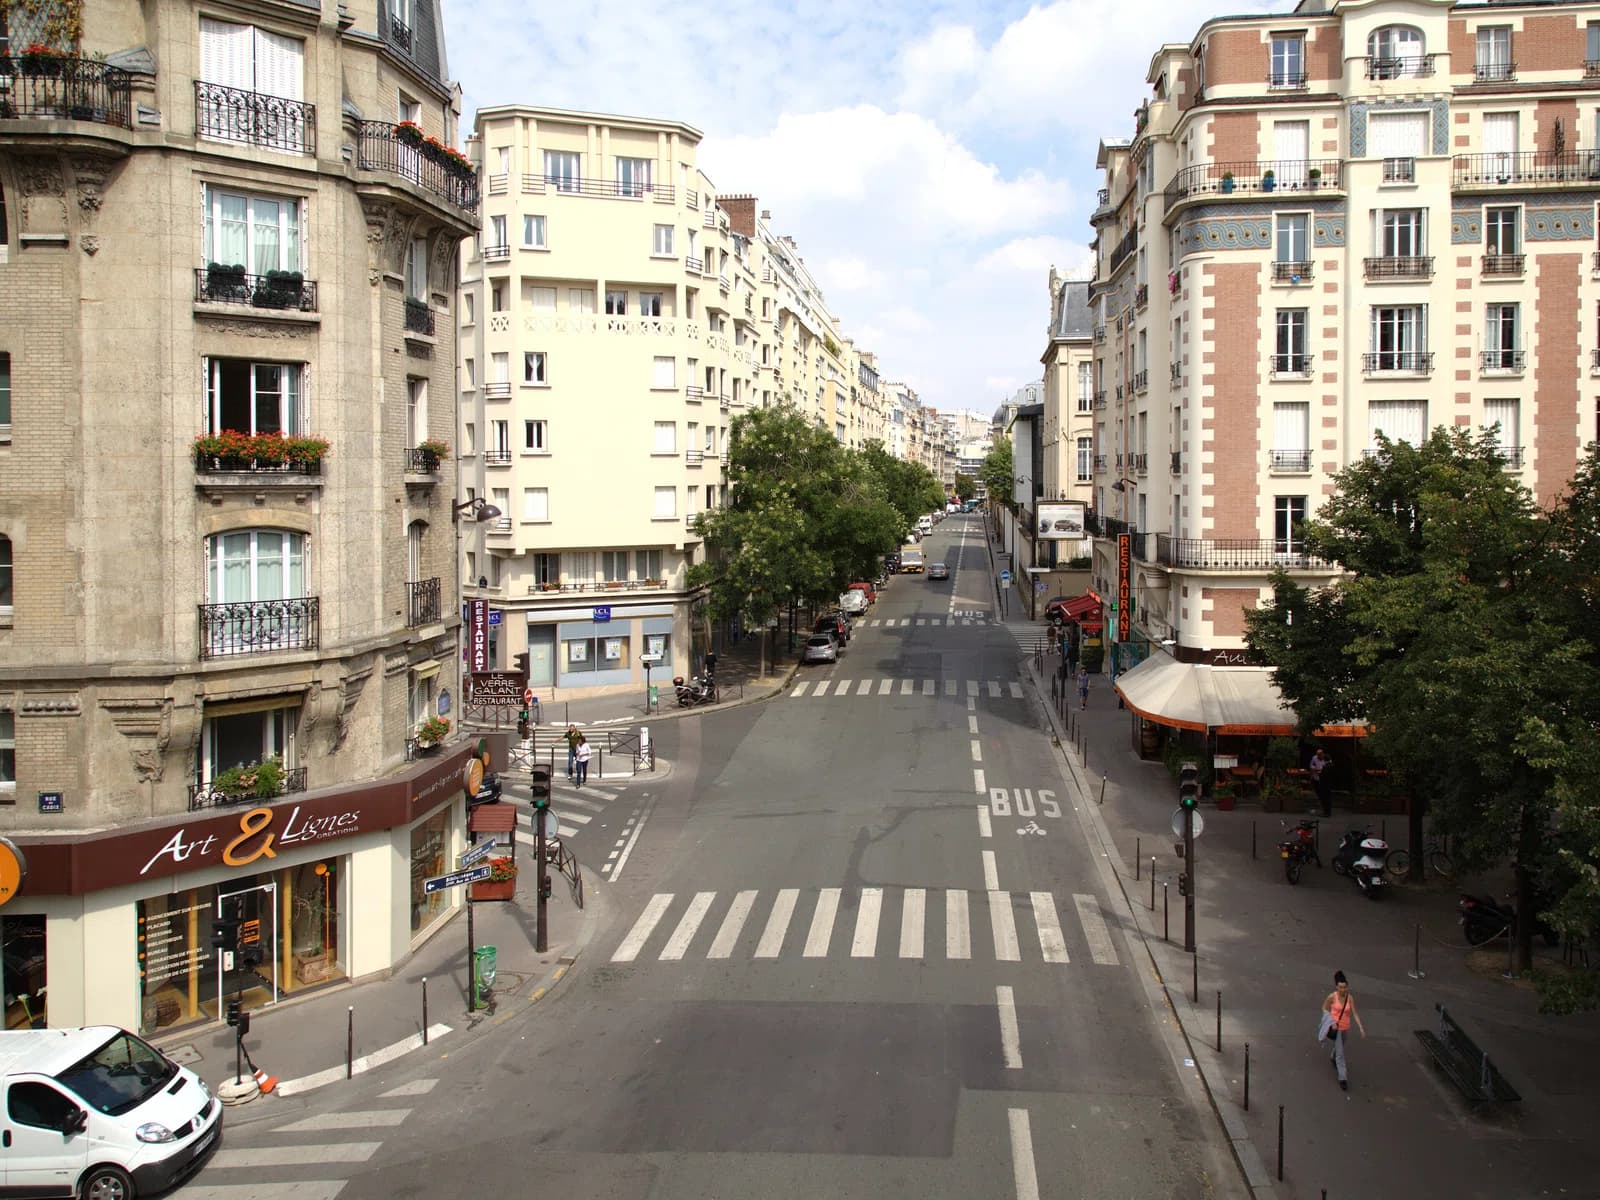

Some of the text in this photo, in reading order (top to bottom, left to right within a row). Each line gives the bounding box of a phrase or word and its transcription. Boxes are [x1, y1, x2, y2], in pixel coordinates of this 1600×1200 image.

[1120, 536, 1129, 641] RESTAURANT
[954, 610, 985, 618] BUS
[475, 601, 484, 671] RESTAURANT
[480, 680, 515, 688] VERRE
[474, 687, 521, 695] GALANT
[473, 697, 521, 705] RESTAURANT
[990, 787, 1062, 818] BUS
[140, 806, 361, 875] Art & Lignes
[147, 920, 171, 930] PLACARD
